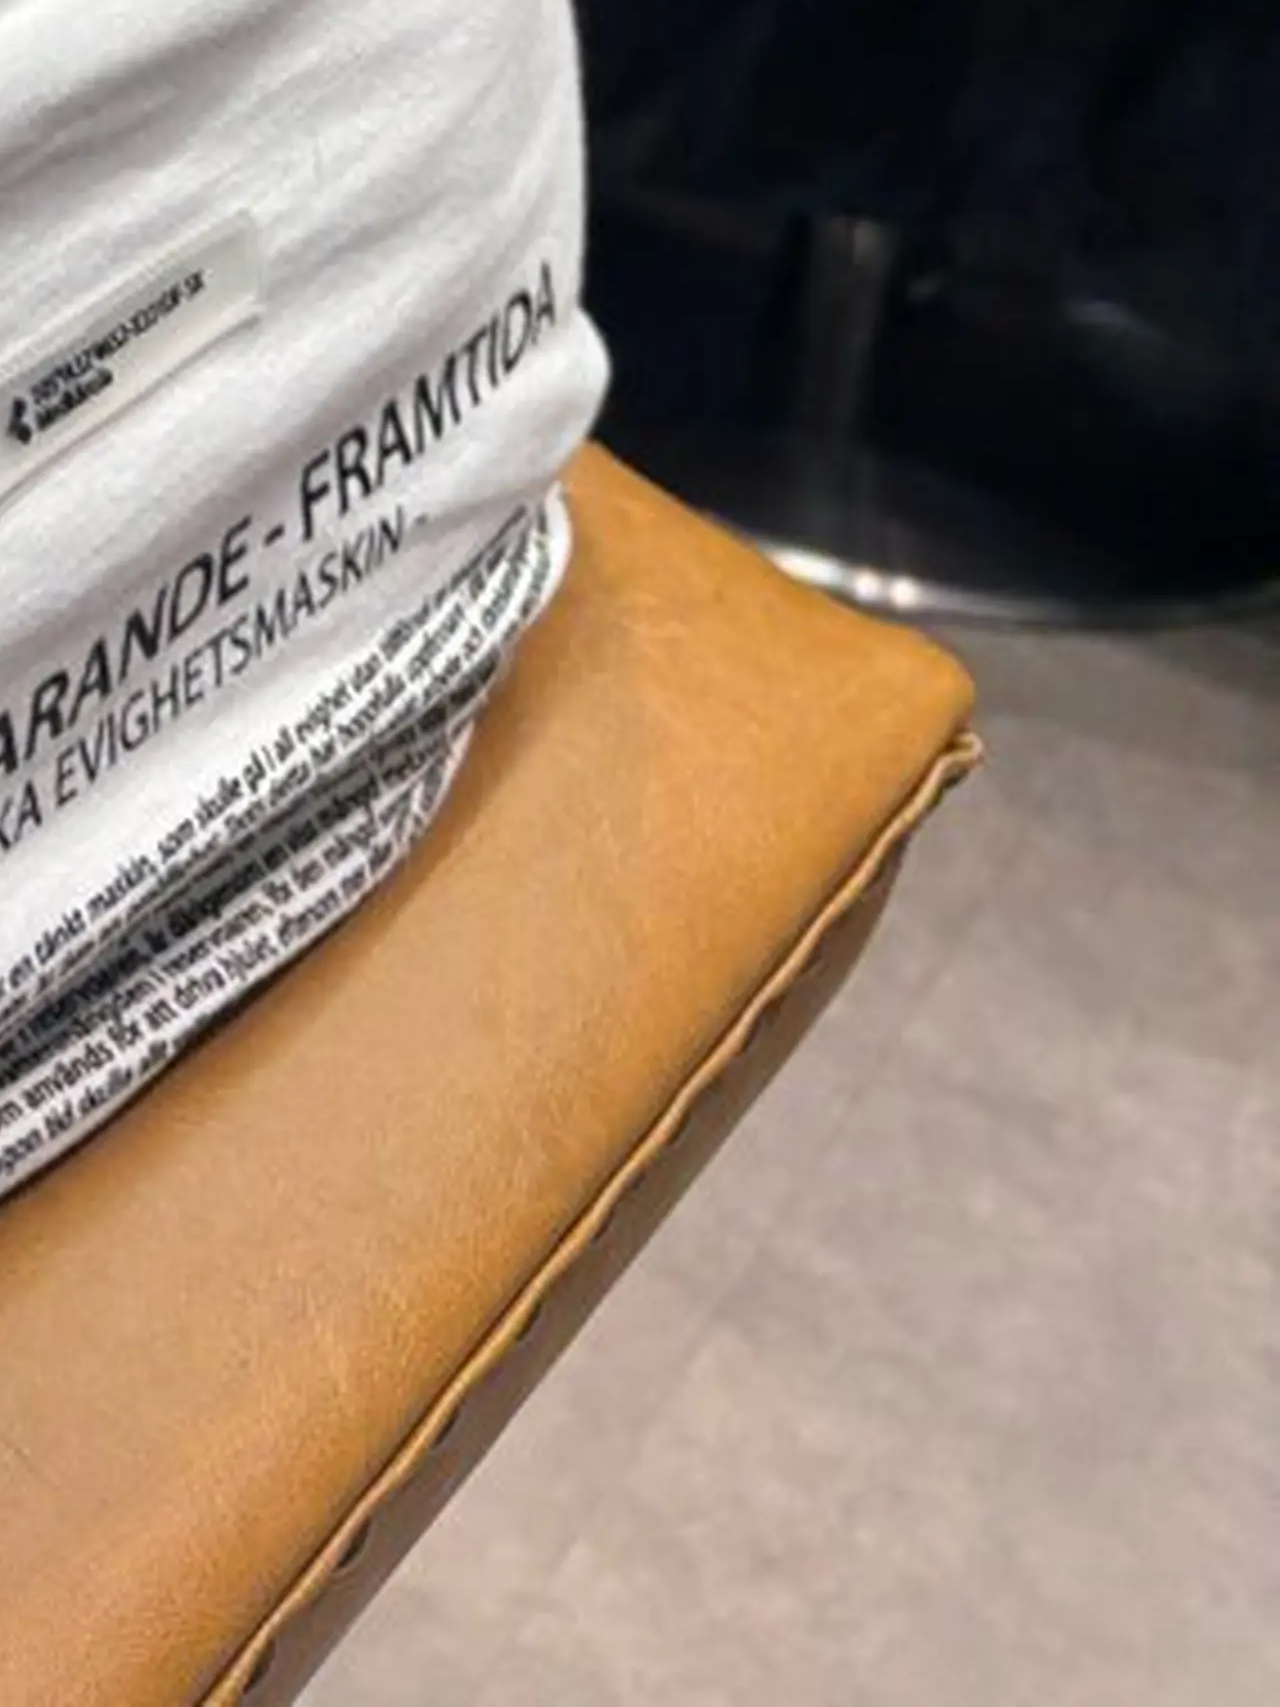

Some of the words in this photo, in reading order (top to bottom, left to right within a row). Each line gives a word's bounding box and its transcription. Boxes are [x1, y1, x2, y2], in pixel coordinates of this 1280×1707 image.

[300, 260, 558, 543] FRAMTIDA
[54, 504, 406, 809] EVIGHETSMASKIN
[157, 817, 194, 864] som
[20, 1040, 116, 1111] används
